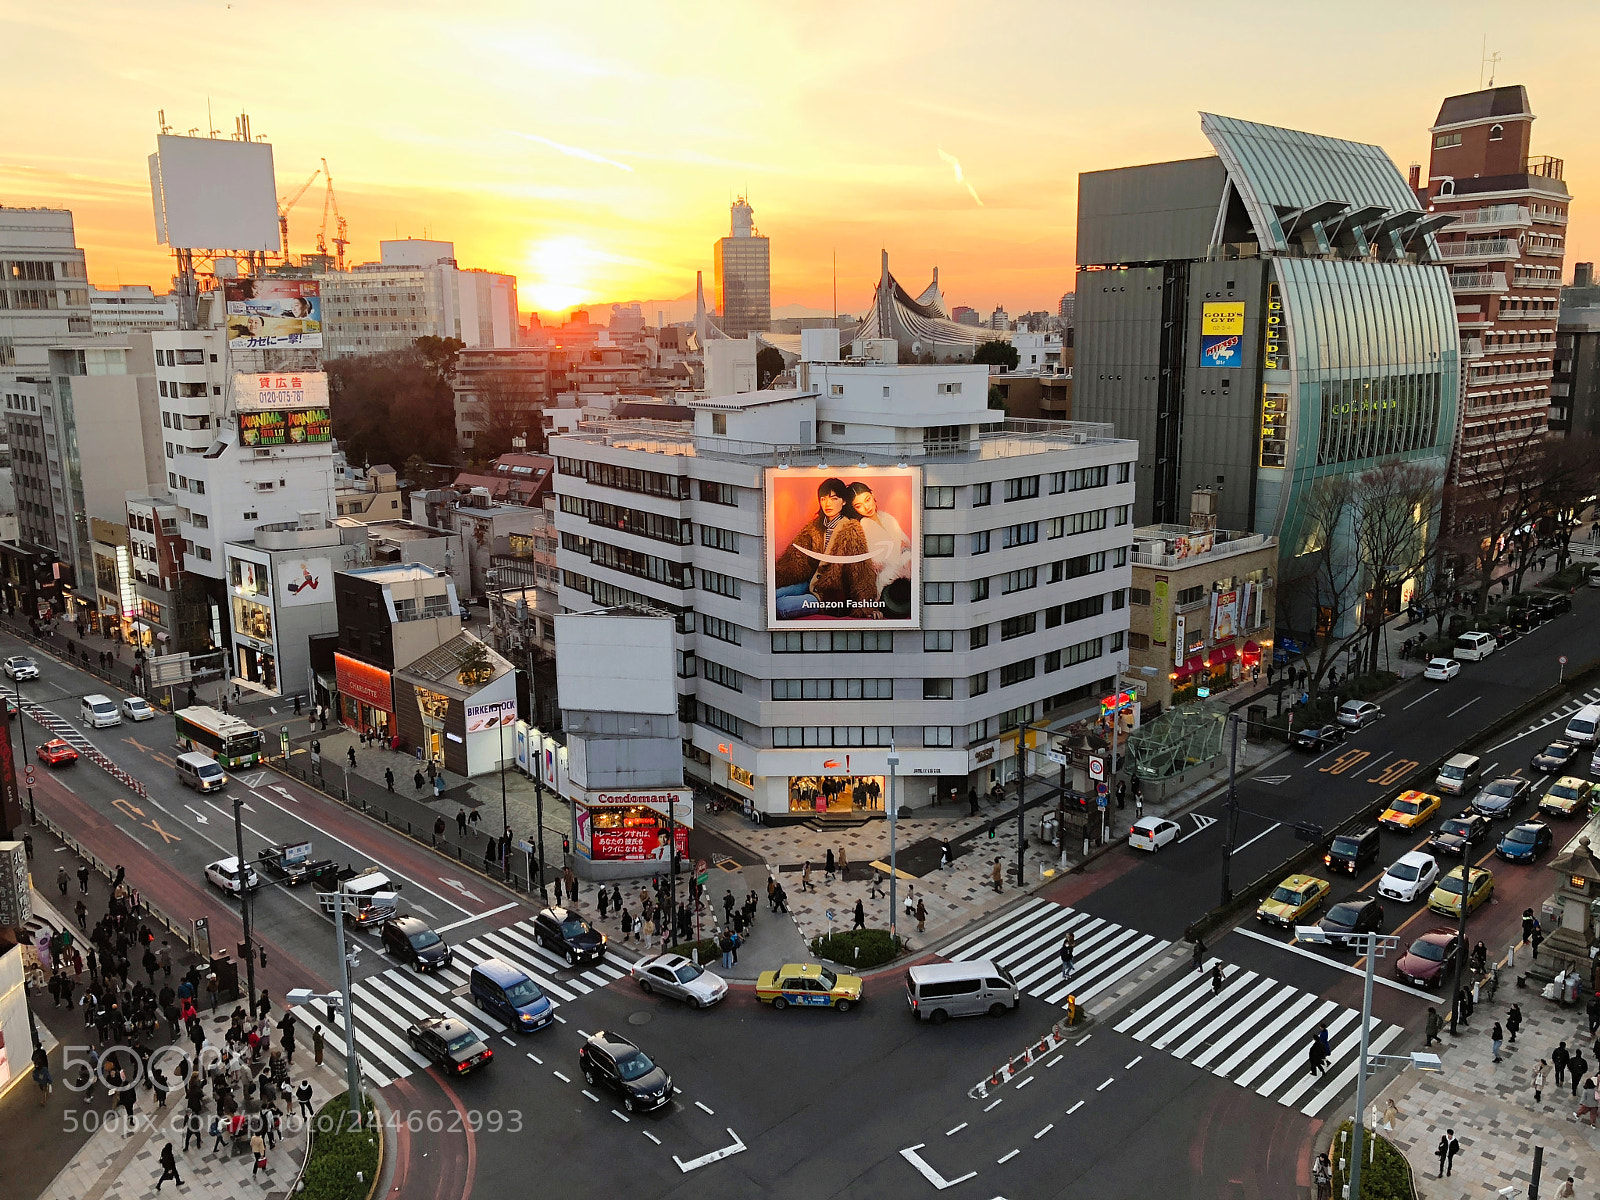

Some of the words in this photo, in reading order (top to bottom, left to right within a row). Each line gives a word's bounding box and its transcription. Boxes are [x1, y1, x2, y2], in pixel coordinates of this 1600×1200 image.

[247, 333, 302, 348] カゼに一撃!
[1265, 302, 1281, 369] GOLD'S
[259, 377, 303, 388] 貸広告
[259, 391, 304, 403] 0120-075-787
[241, 411, 283, 428] WANIMA
[288, 409, 328, 426] WANIMA
[1263, 400, 1277, 436] GYM
[802, 600, 844, 609] Amazon
[846, 599, 886, 608] Fashion
[349, 681, 378, 698] CHARLOTTE
[467, 700, 515, 717] BIRKENSOCK
[1318, 749, 1371, 775] 50
[1366, 759, 1419, 785] 50
[598, 793, 680, 804] Condomania
